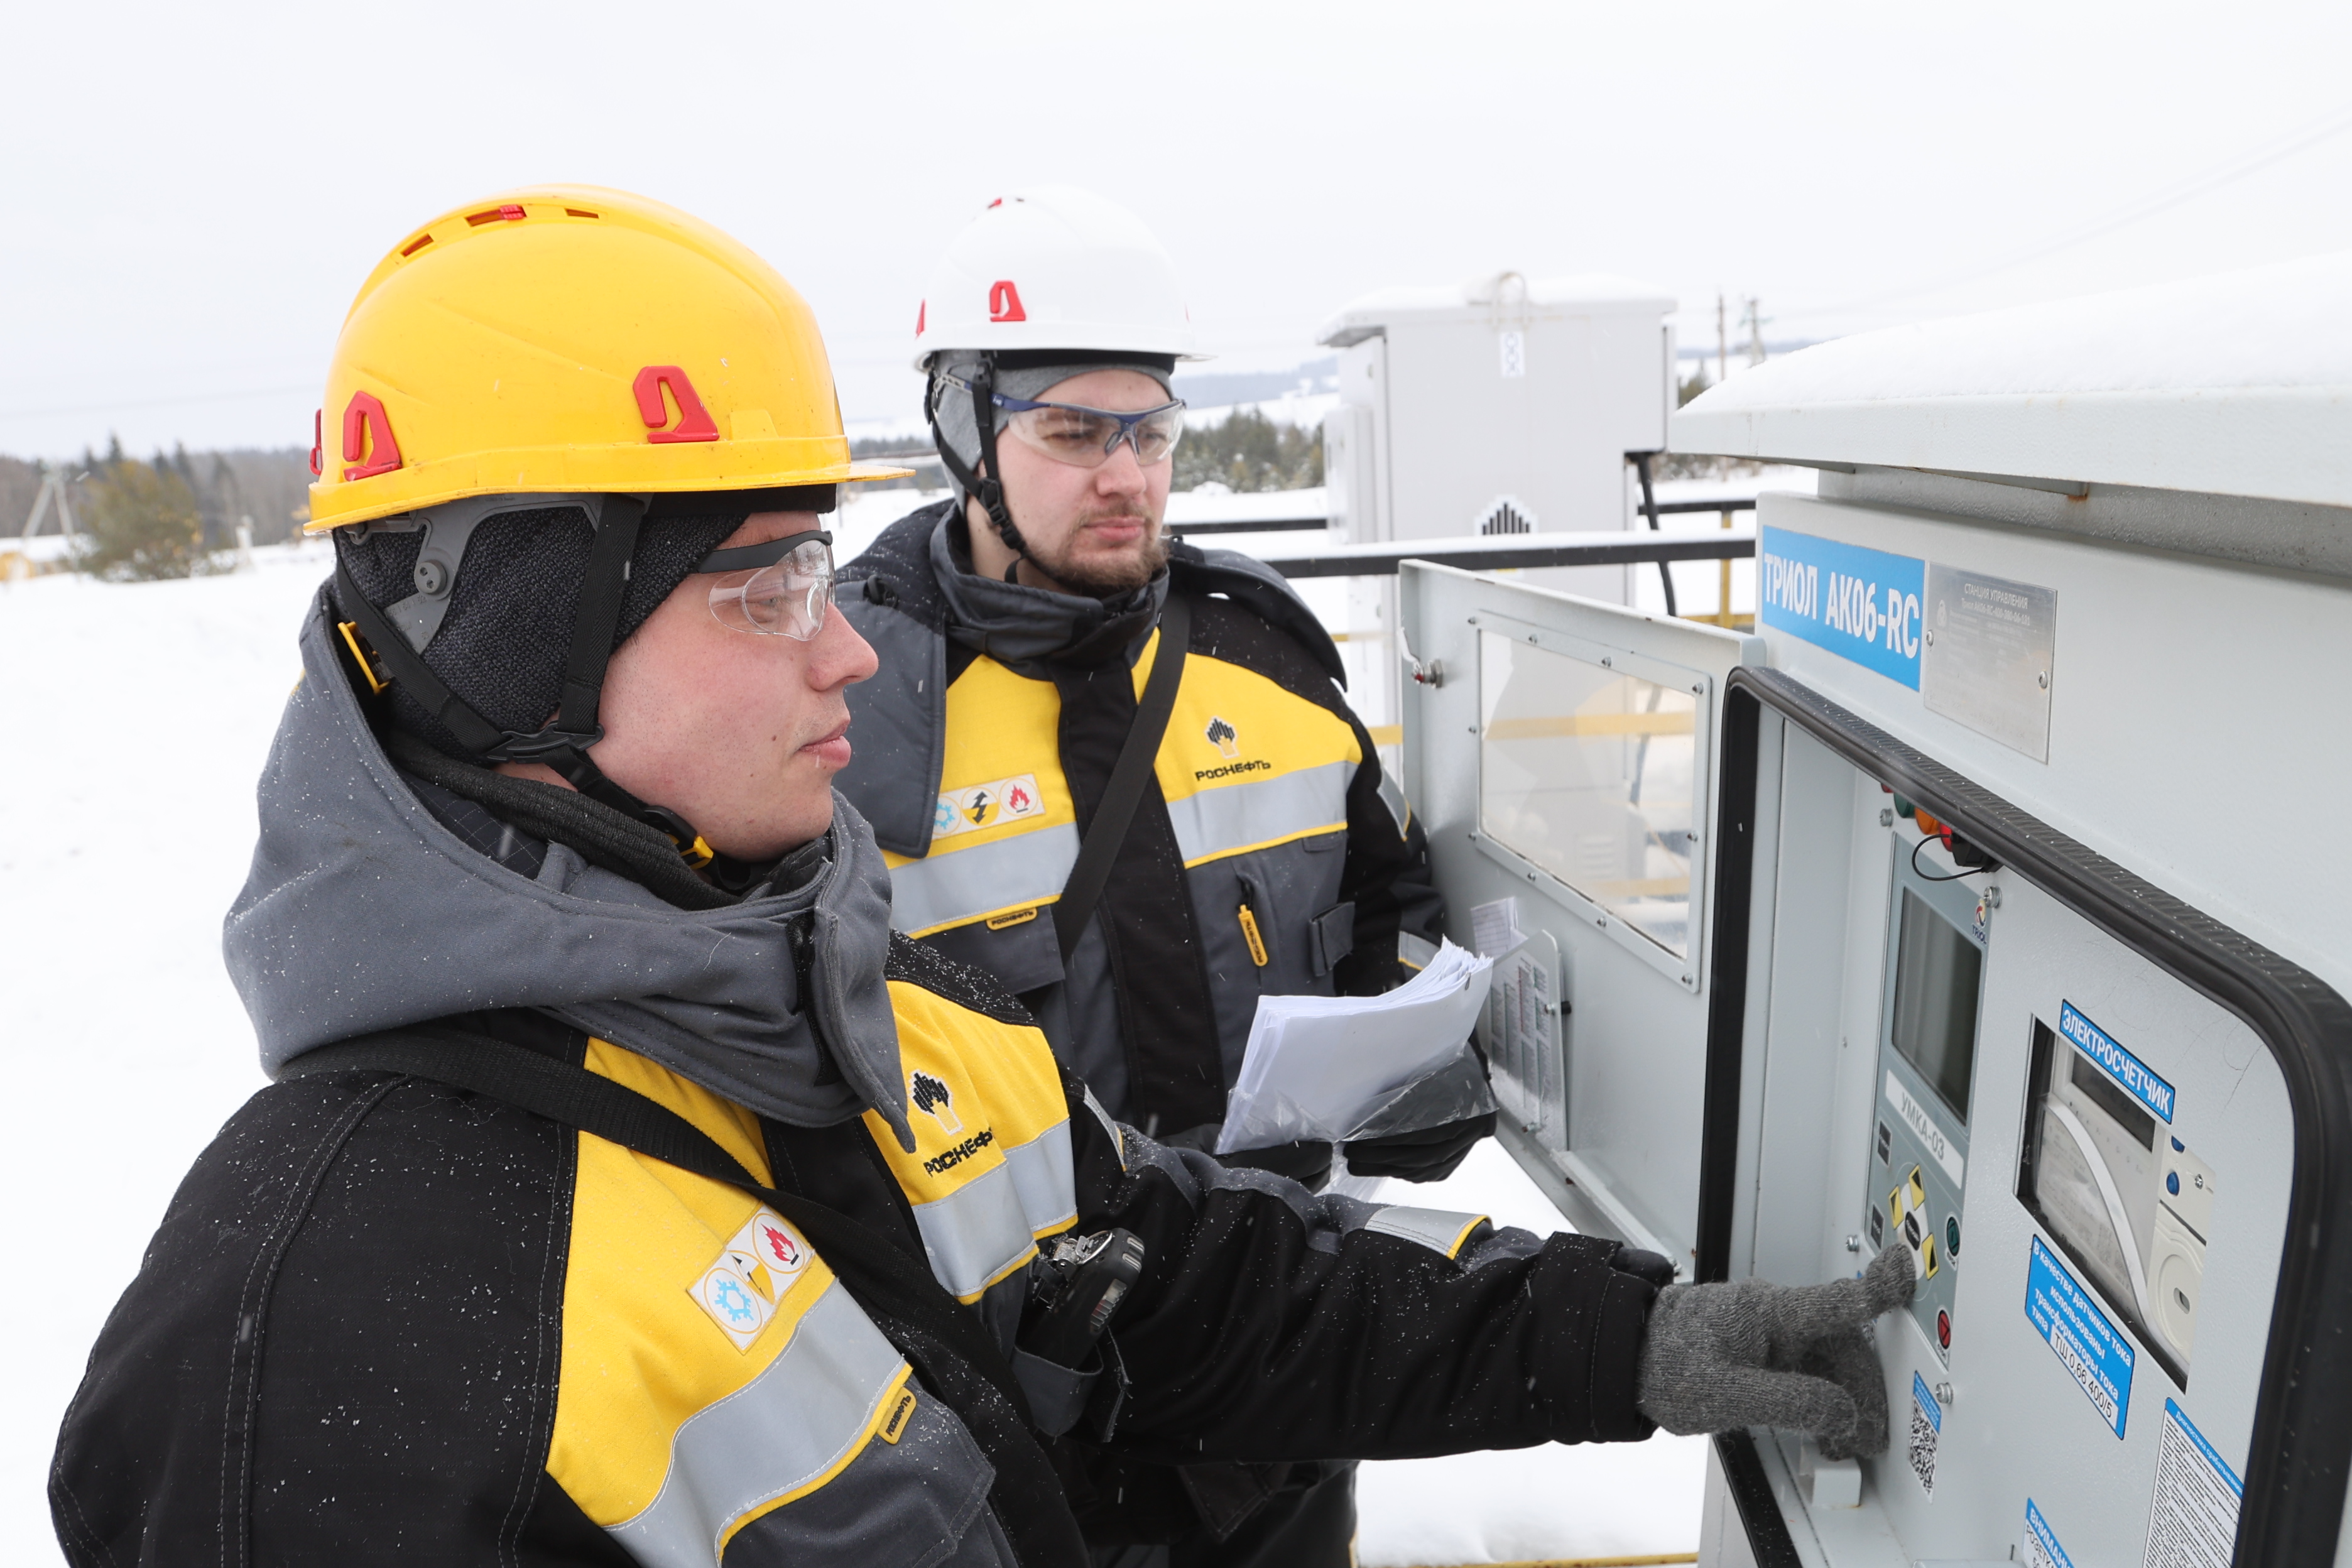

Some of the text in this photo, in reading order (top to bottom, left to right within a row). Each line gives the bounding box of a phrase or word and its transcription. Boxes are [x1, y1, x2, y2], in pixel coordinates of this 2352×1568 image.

[1764, 552, 1817, 620] ТРИОЛ
[1964, 583, 2028, 609] СТАНЦИЯ УПРАВЛЕНИЯ
[1195, 760, 1271, 781] РОСНЕФТЬ
[991, 910, 1034, 926] РОСНЕФТЬ
[1971, 924, 1987, 945] TRIOL
[2063, 1008, 2171, 1116] ЭЛЕКТРОСЧЕТЧИК
[922, 1130, 993, 1178] РОСНЕФ
[1901, 1091, 1945, 1161] УМКА-03
[2034, 1241, 2132, 1368] В качестве датчиков тока
[2050, 1285, 2106, 1359] использованы
[2032, 1305, 2113, 1418] типа ТШ 0,66 400/5
[2034, 1287, 2099, 1376] трансформаторы
[2099, 1369, 2119, 1401] тока
[885, 1395, 912, 1437] РОСНЕФТЬ
[2175, 1410, 2207, 1451] Диагностика
